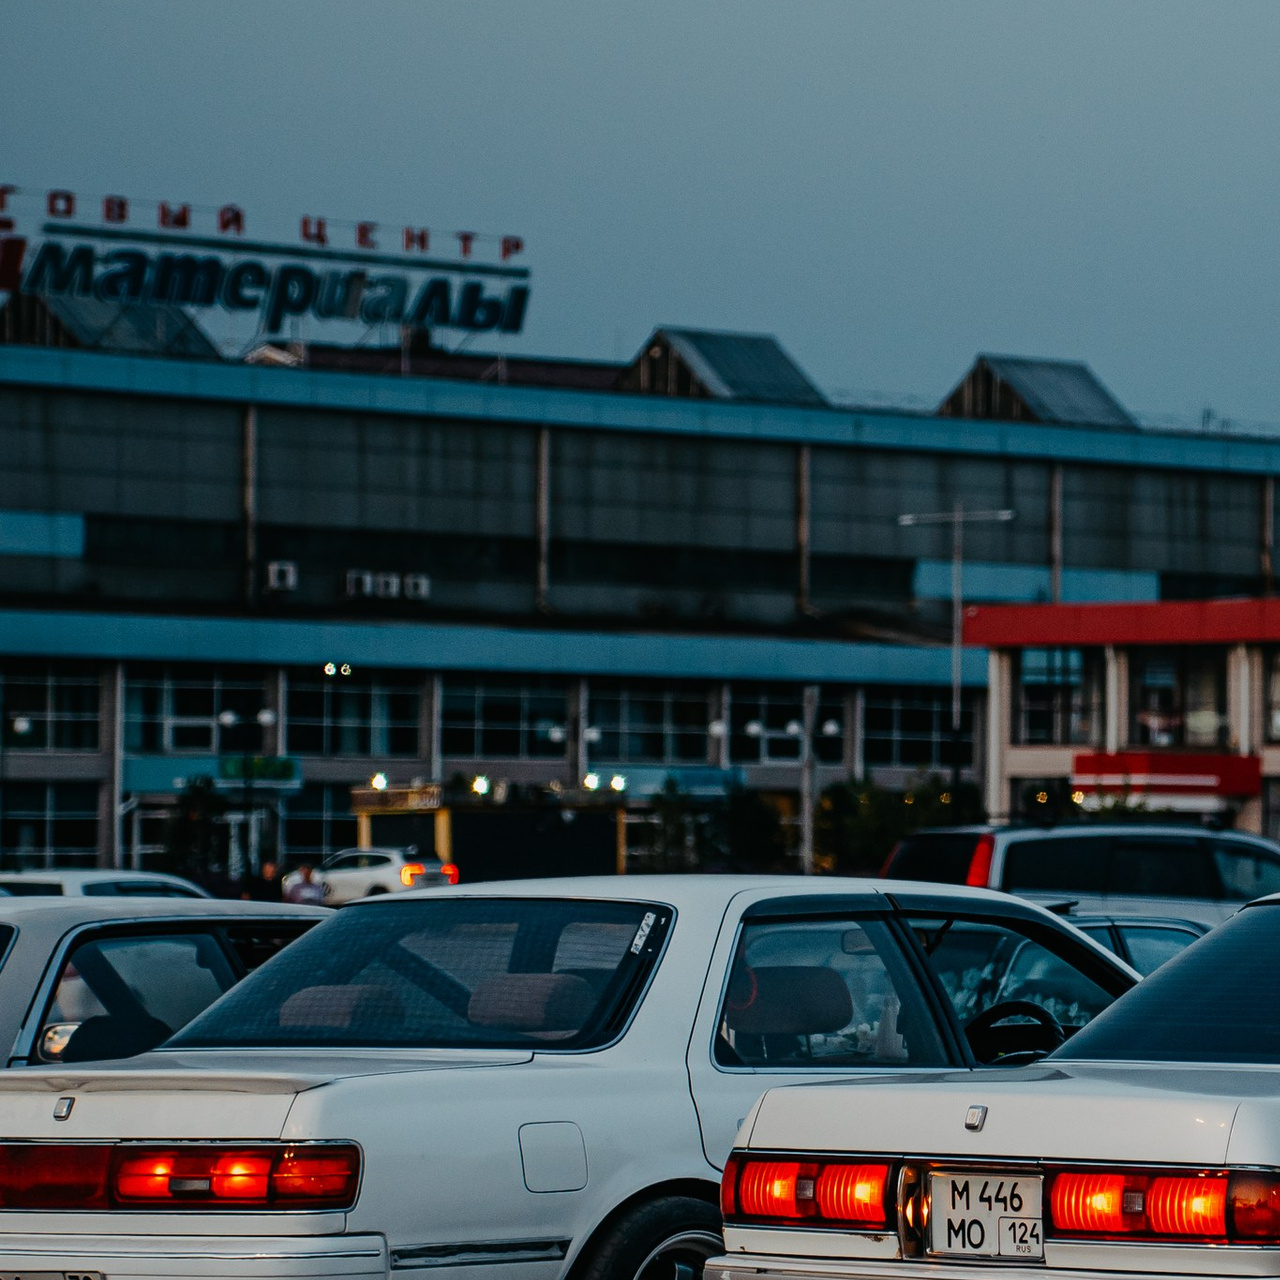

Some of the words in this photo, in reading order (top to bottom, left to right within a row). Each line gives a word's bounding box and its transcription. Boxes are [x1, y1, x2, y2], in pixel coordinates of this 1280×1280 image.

[300, 214, 524, 260] ЦЕНТР
[979, 1181, 1023, 1211] 446
[1008, 1222, 1040, 1244] 124
[1016, 1245, 1032, 1253] RUS
